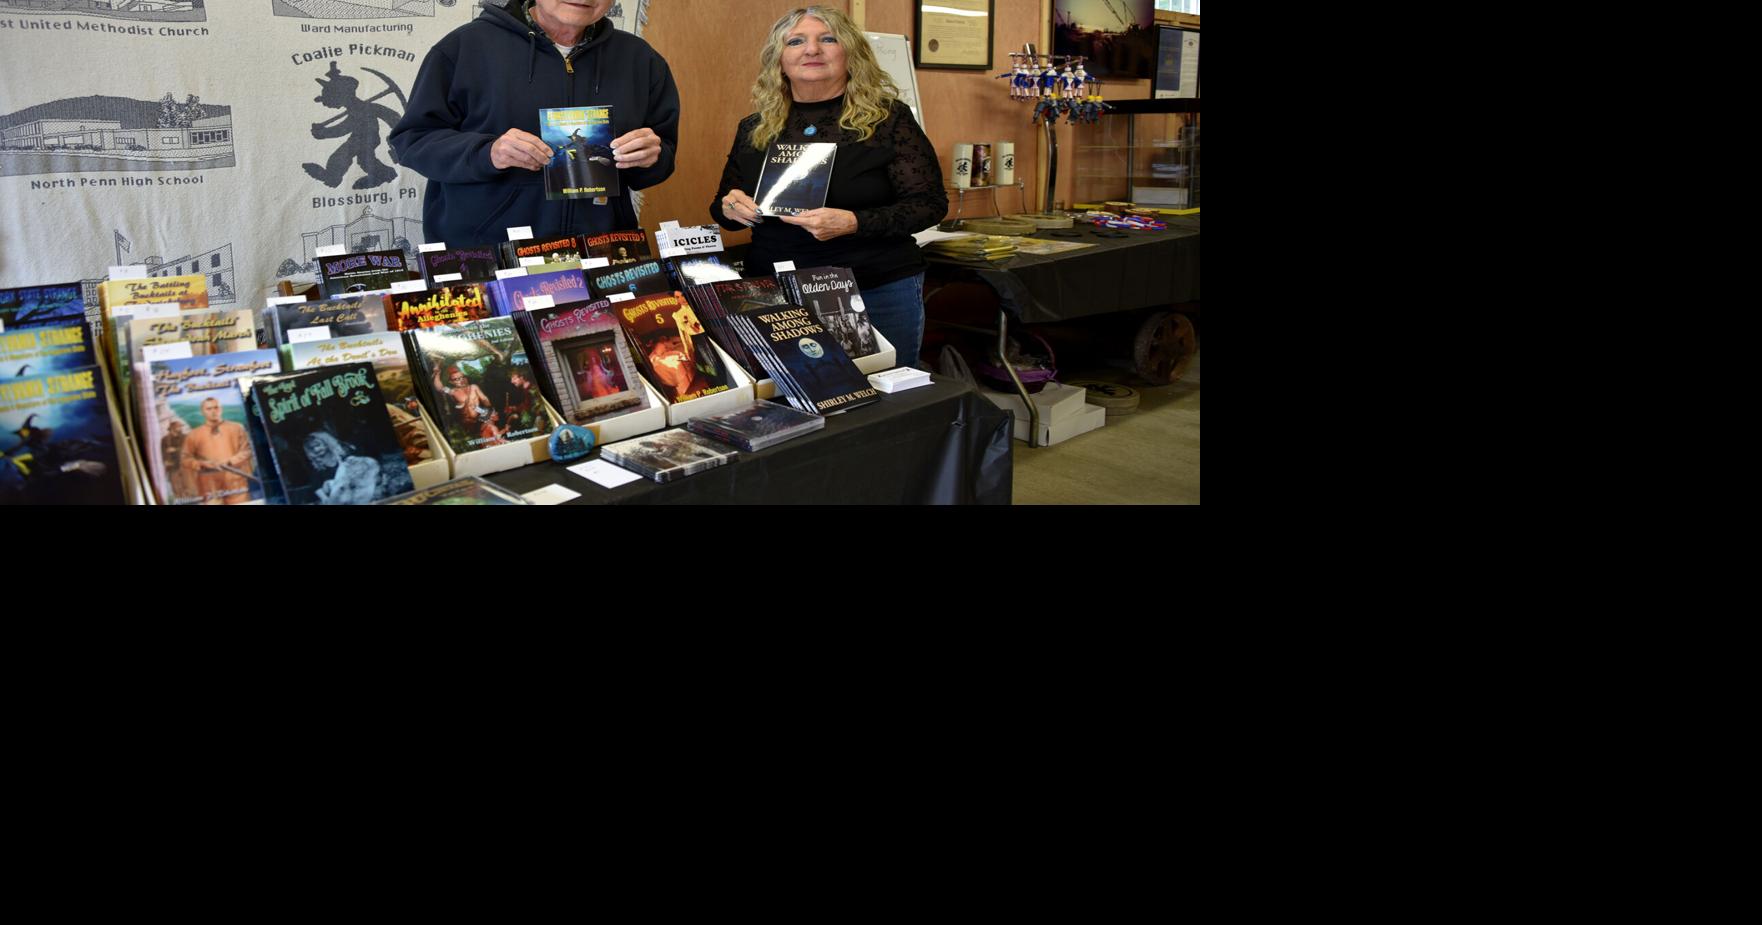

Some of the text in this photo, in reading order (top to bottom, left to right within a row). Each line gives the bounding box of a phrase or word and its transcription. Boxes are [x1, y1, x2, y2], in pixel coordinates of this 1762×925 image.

[19, 19, 73, 30] United
[77, 21, 154, 36] Methodist
[159, 26, 209, 36] Church
[301, 23, 413, 33] Ward Manufacturing
[291, 43, 416, 66] Coalie Pickman
[31, 175, 205, 190] North Penn High School
[312, 188, 417, 208] Blossburg, PA
[587, 235, 611, 247] GHOSTS
[610, 233, 641, 243] REVISITED
[673, 235, 718, 247] ICICLES
[517, 244, 541, 257] GHOSTS
[541, 239, 571, 252] REVISITED
[325, 255, 403, 275] MORE WAR
[596, 262, 660, 289] GHOSTS REVISITED
[811, 274, 822, 282] Fun
[829, 272, 839, 280] the
[125, 281, 191, 293] The Battling
[802, 279, 854, 294] Olden Days
[130, 290, 176, 300] Bucktails
[400, 286, 482, 317] Annihilated
[298, 304, 316, 314] The
[540, 300, 610, 333] GHOSTS REVISITED
[623, 297, 678, 323] GHOSTS REVISITED
[758, 307, 810, 324] WALKING
[310, 313, 358, 325] Last Call
[417, 311, 469, 323] Alleghenies
[655, 313, 664, 324] 5
[771, 316, 812, 332] AMONG
[150, 322, 178, 335] The
[770, 324, 824, 342] SHADOWS
[317, 344, 336, 352] The
[307, 356, 321, 366] At
[325, 355, 338, 364] the
[379, 348, 398, 357] Den
[155, 382, 182, 397] The
[268, 392, 302, 424] Spirit
[300, 388, 313, 407] of
[309, 379, 334, 406] Fall
[332, 368, 375, 398] Brook
[816, 388, 877, 410] SHIRLEY M. WELCH
